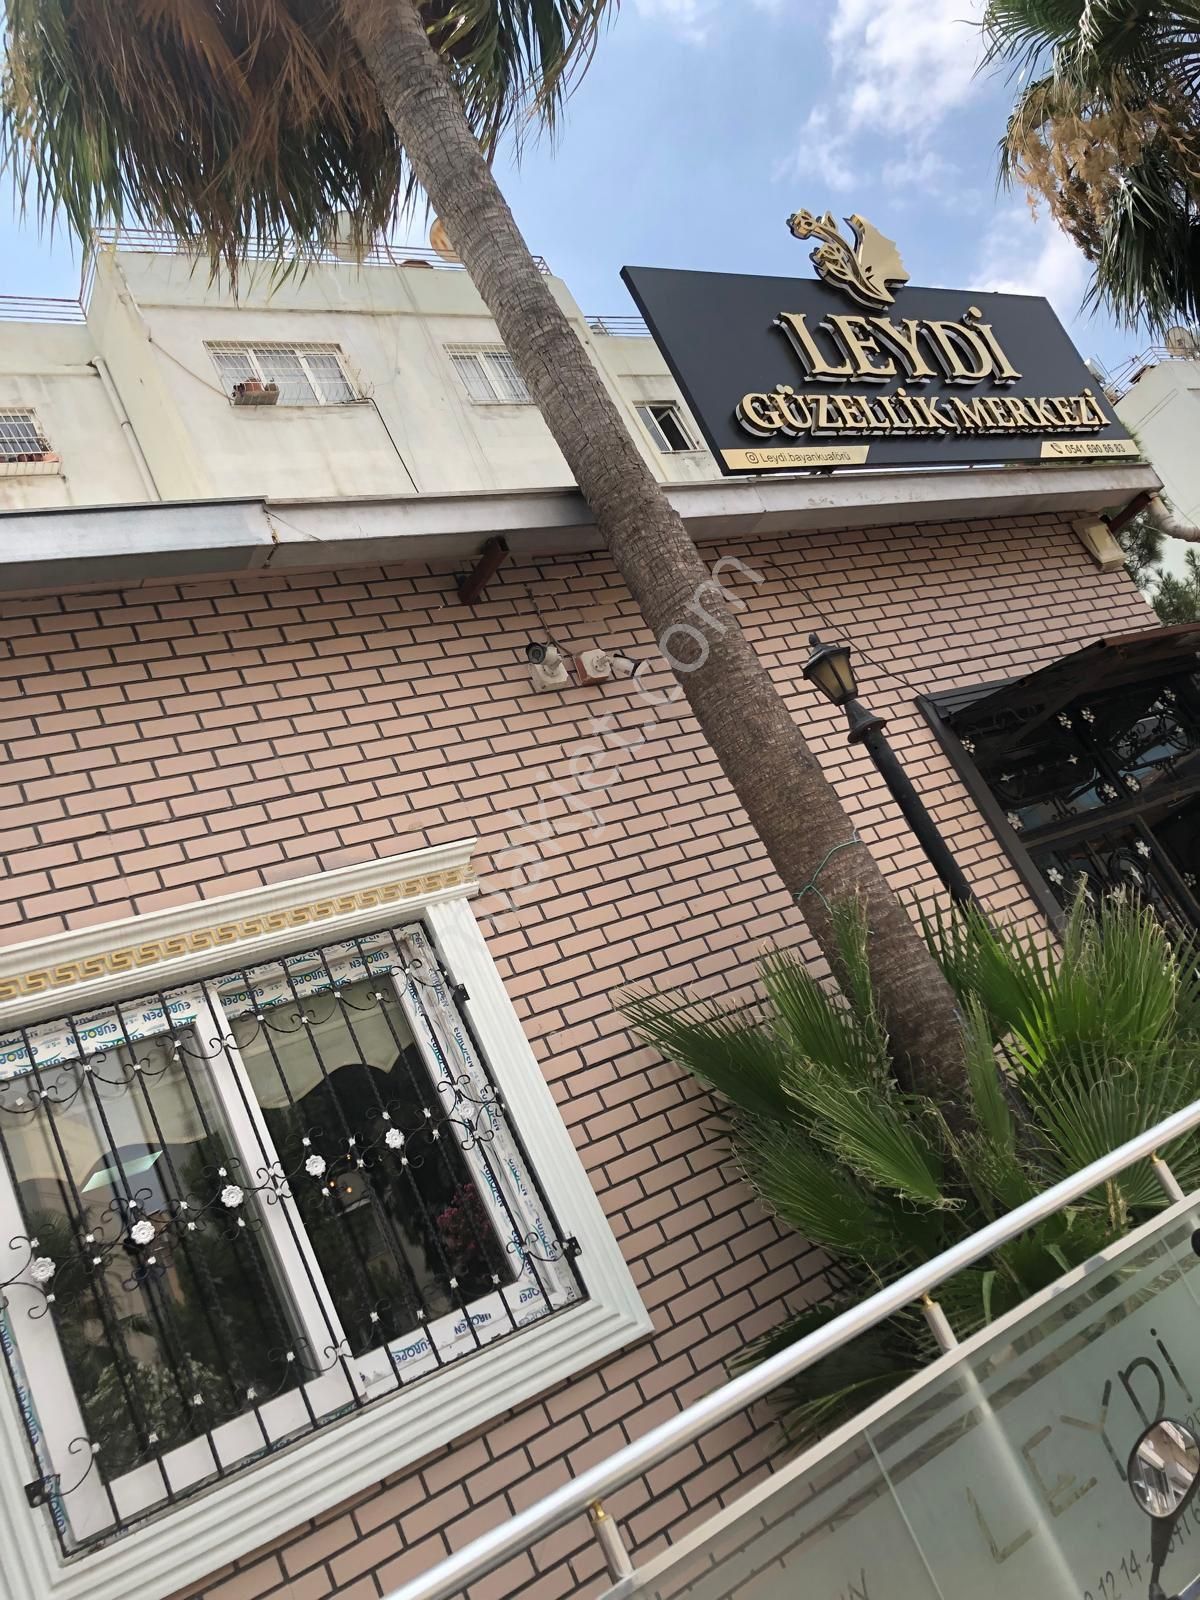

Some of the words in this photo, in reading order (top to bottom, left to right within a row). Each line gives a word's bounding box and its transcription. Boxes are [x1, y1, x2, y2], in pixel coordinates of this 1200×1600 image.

[775, 306, 1023, 384] LEYDİ
[737, 384, 957, 436] GÜZELLİK
[949, 387, 1111, 434] MERKEZİ
